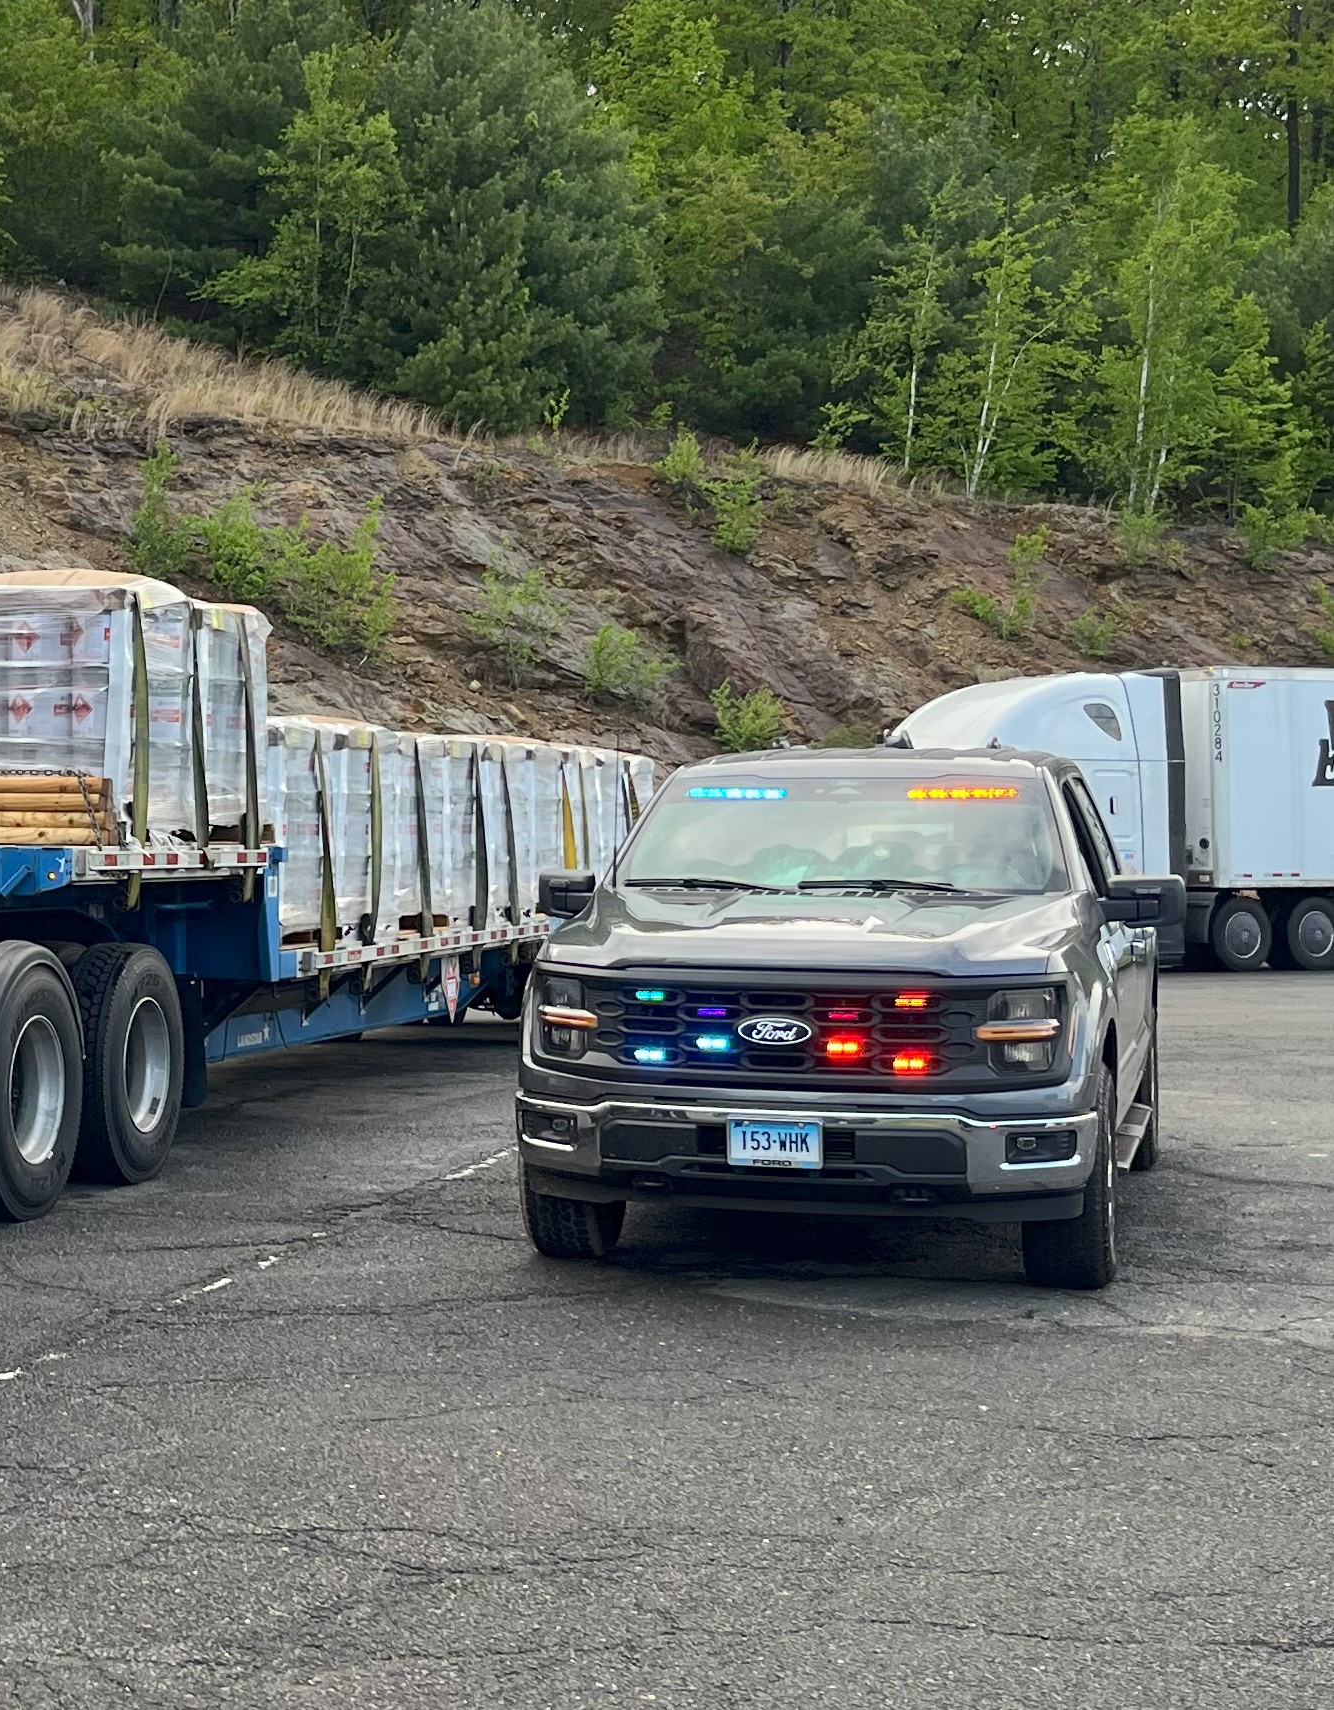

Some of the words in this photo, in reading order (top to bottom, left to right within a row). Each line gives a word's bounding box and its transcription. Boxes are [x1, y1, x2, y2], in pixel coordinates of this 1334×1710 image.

[1213, 684, 1222, 762] 310284
[751, 1021, 798, 1041] Ford
[753, 1159, 792, 1167] FORD
